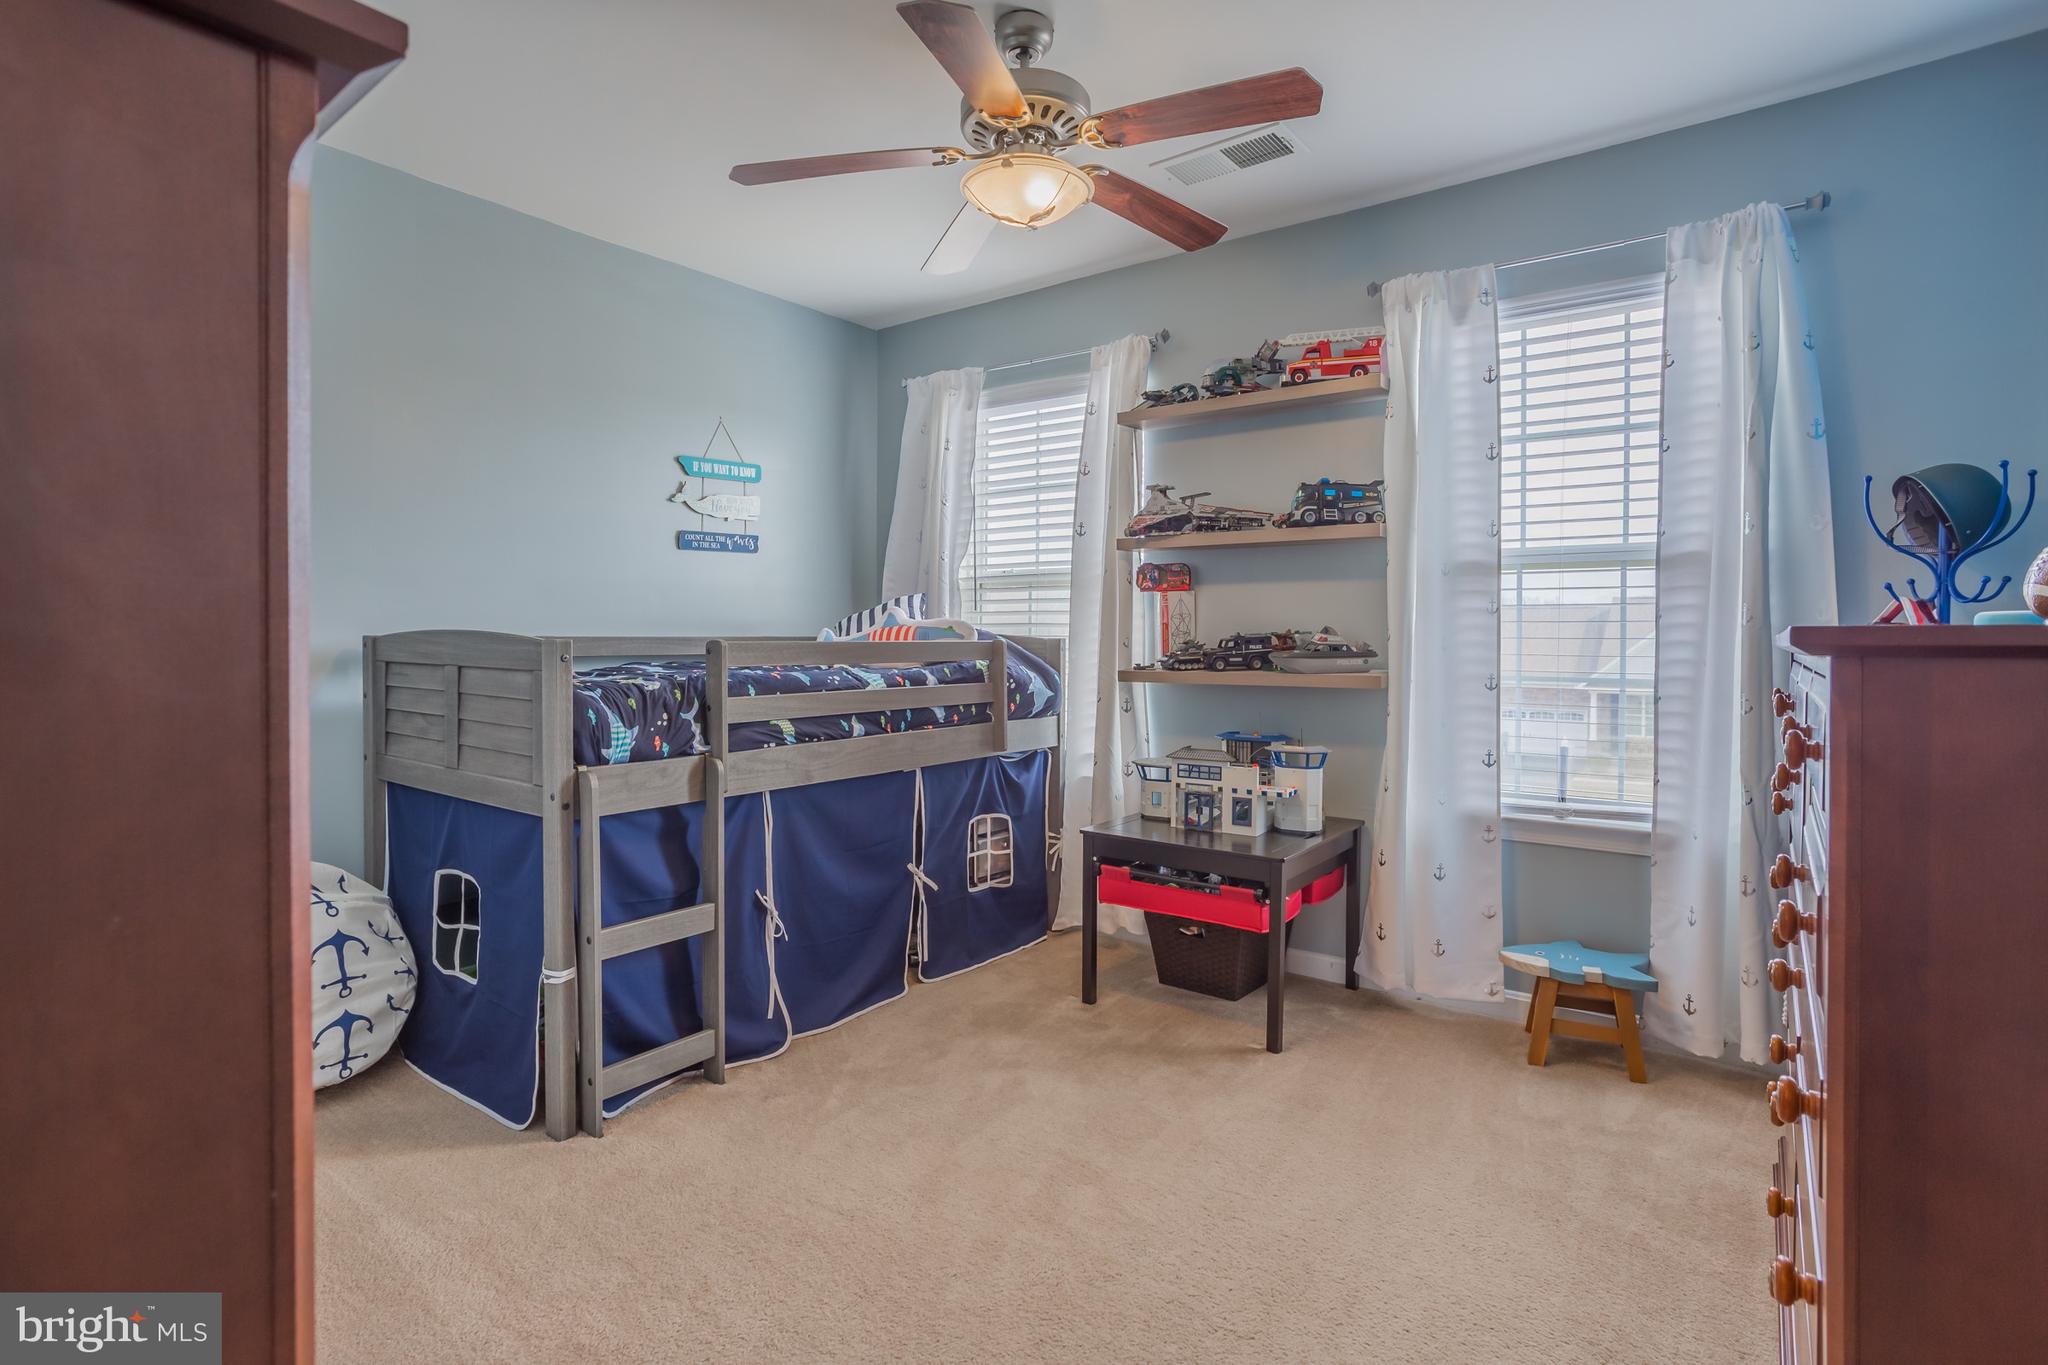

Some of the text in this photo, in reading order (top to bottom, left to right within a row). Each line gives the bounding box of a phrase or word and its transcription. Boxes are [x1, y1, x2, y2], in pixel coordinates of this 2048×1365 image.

[693, 461, 756, 478] IF YOU WANT TO KNOW
[685, 533, 704, 541] COUNT
